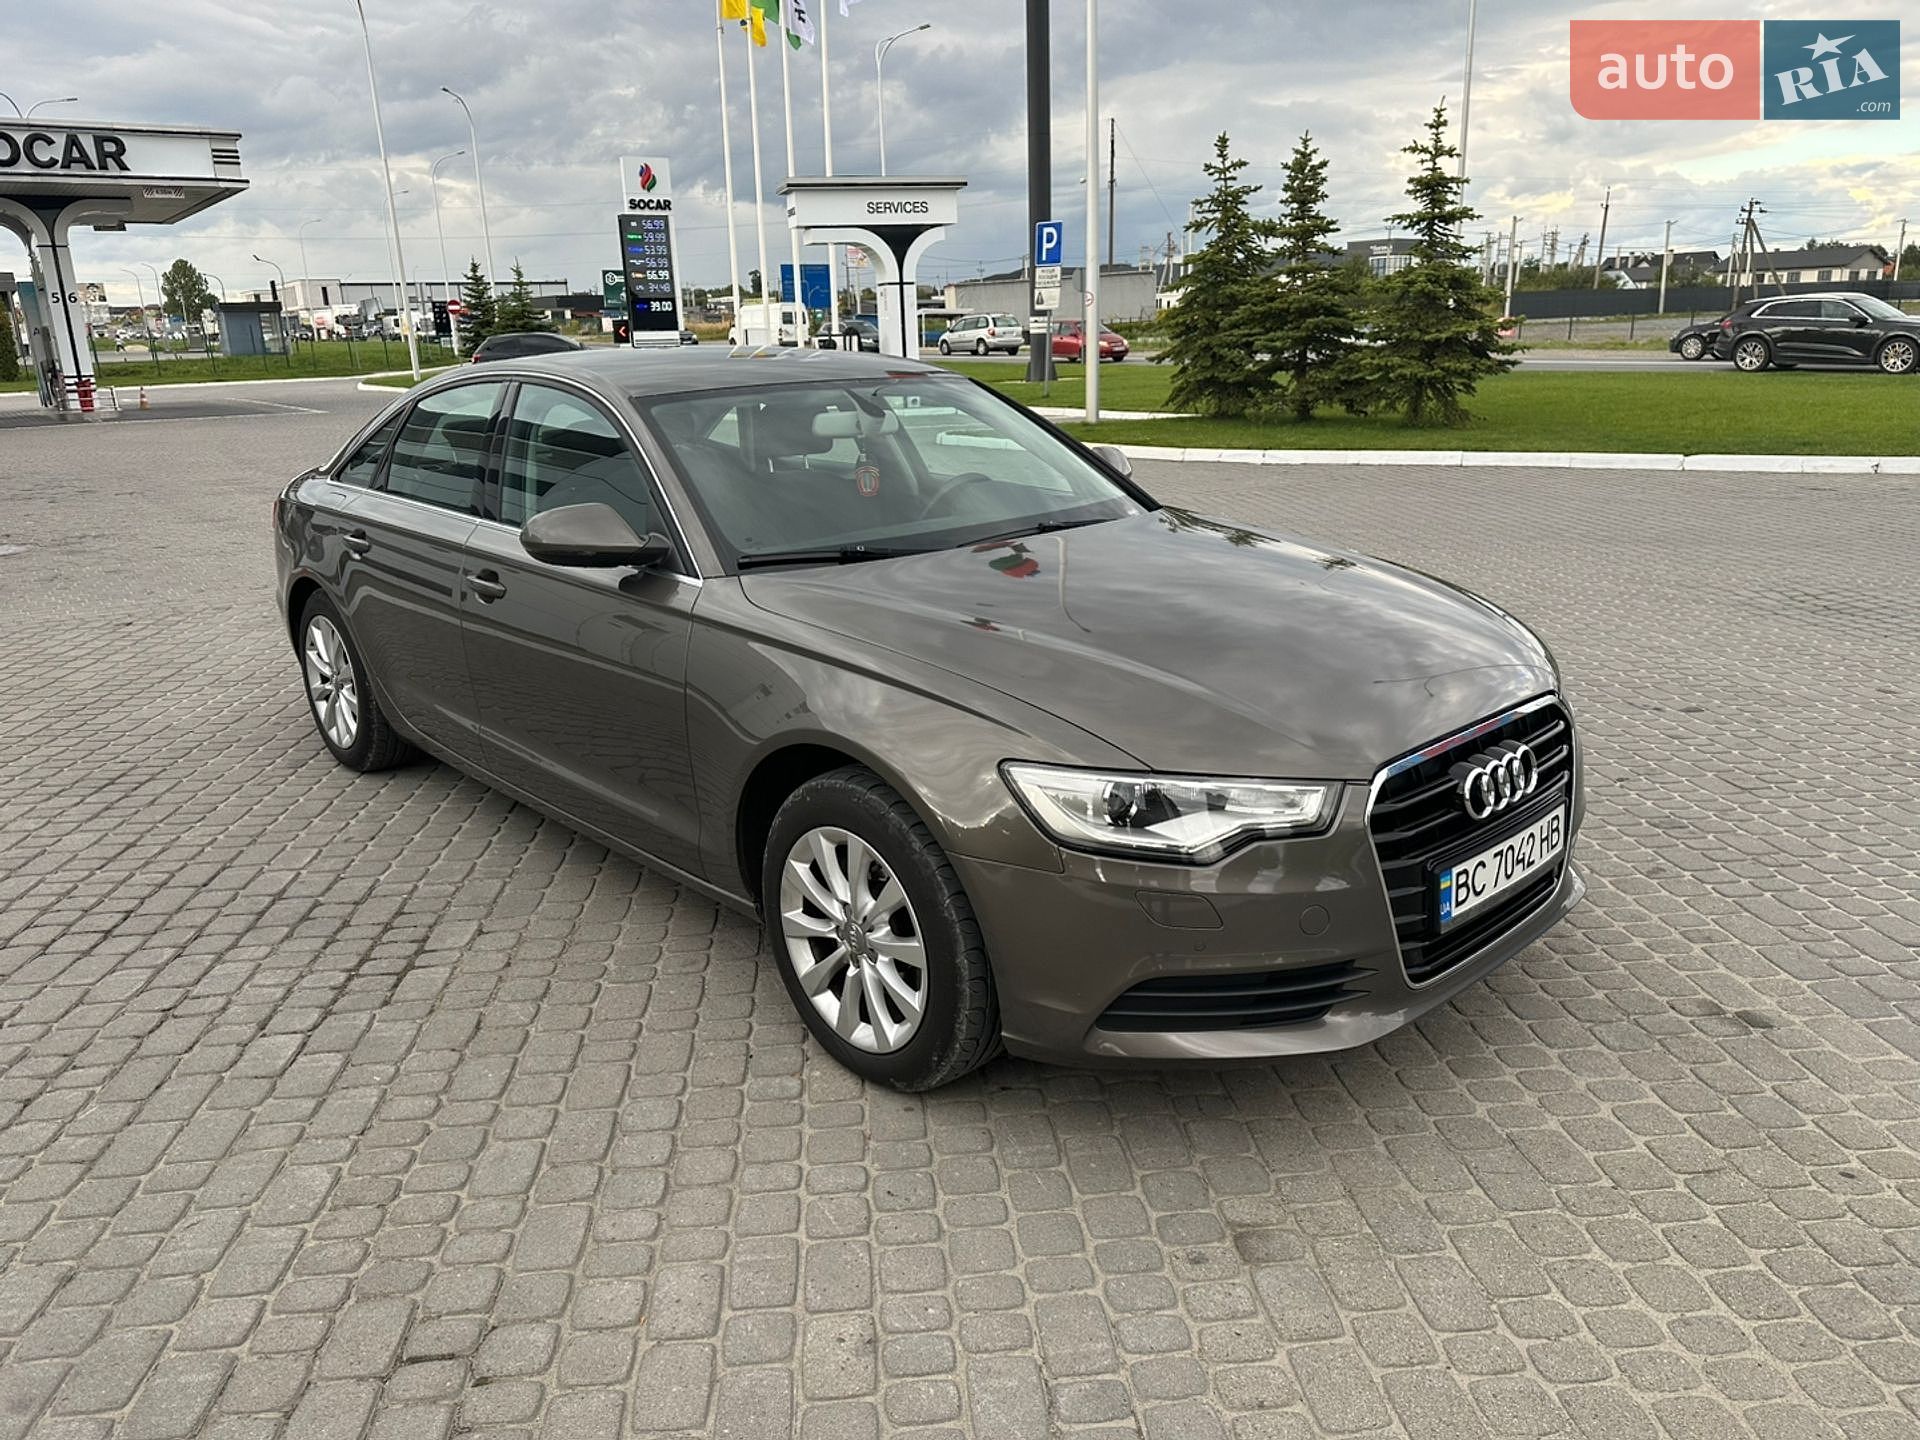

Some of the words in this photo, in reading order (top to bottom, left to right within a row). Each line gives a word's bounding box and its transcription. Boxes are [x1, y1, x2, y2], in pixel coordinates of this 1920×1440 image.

[629, 198, 672, 211] SOCAR
[866, 201, 929, 214] SERVICES
[1042, 226, 1058, 261] P
[51, 292, 60, 304] 5
[68, 291, 78, 304] 6
[1455, 860, 1487, 908] BC
[1493, 832, 1536, 888] 7042
[1540, 814, 1561, 859] HB
